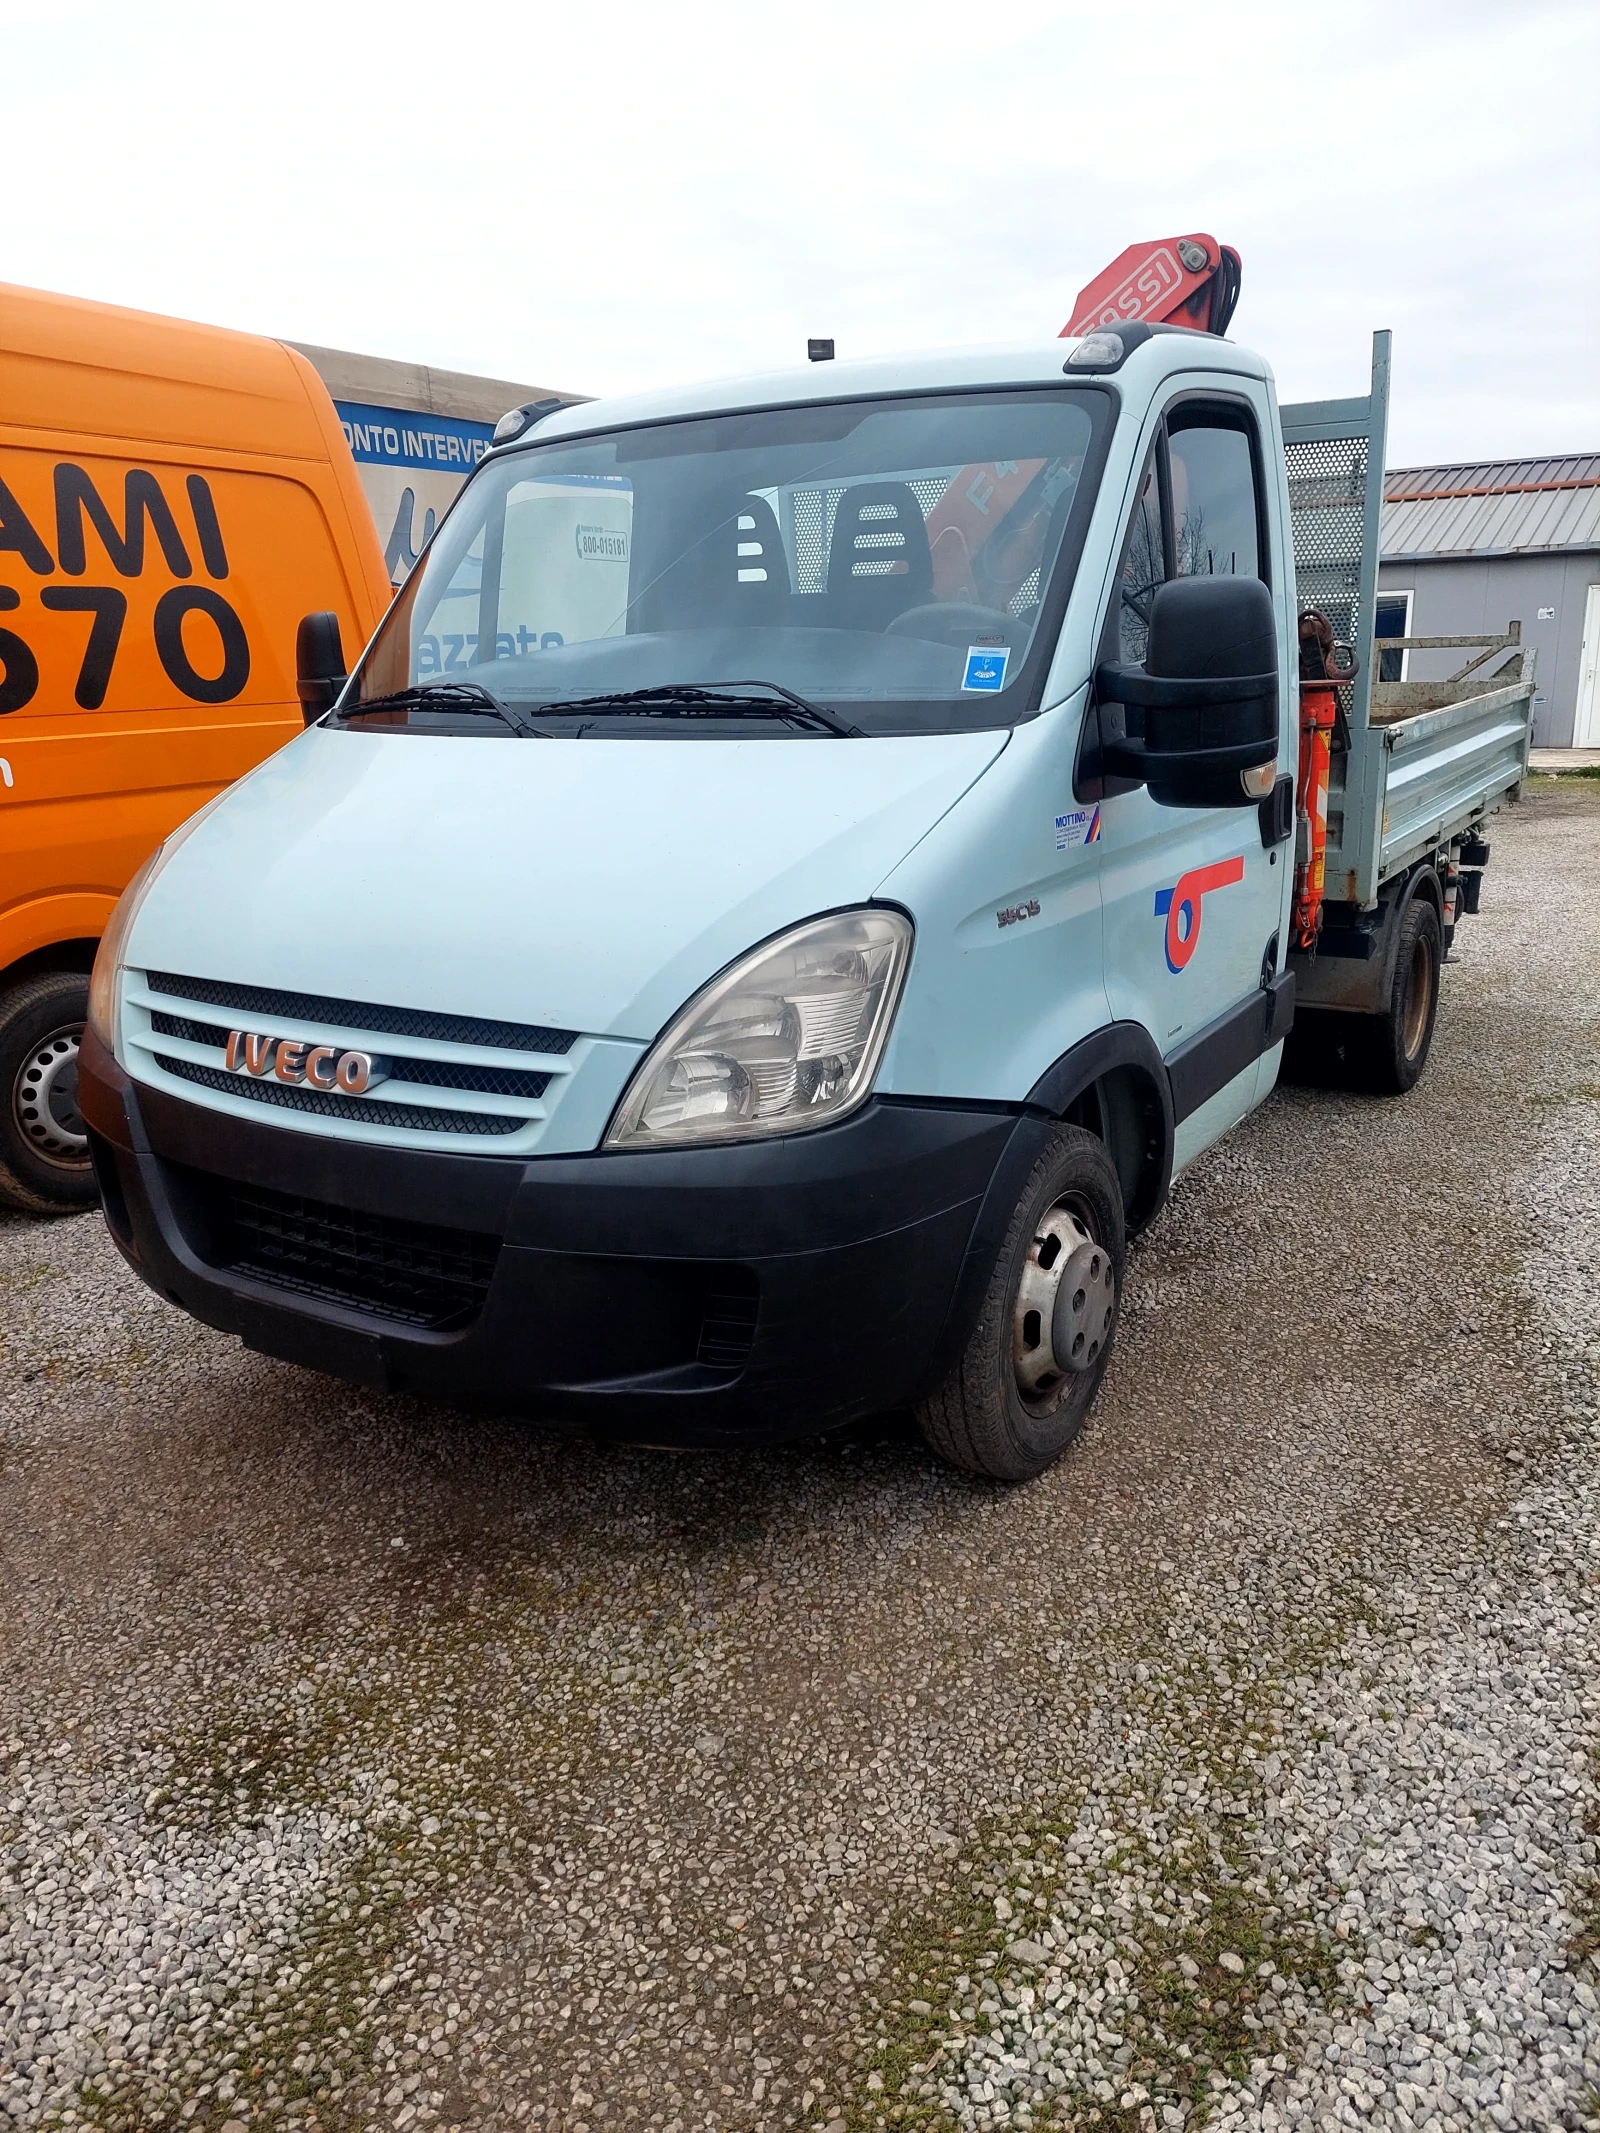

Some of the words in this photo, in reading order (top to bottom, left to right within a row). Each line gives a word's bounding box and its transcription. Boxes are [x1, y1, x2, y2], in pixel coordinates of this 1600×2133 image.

[583, 535, 626, 556] 800-015181
[1055, 811, 1086, 829] MOTTINO
[225, 1030, 373, 1095] IVECO
